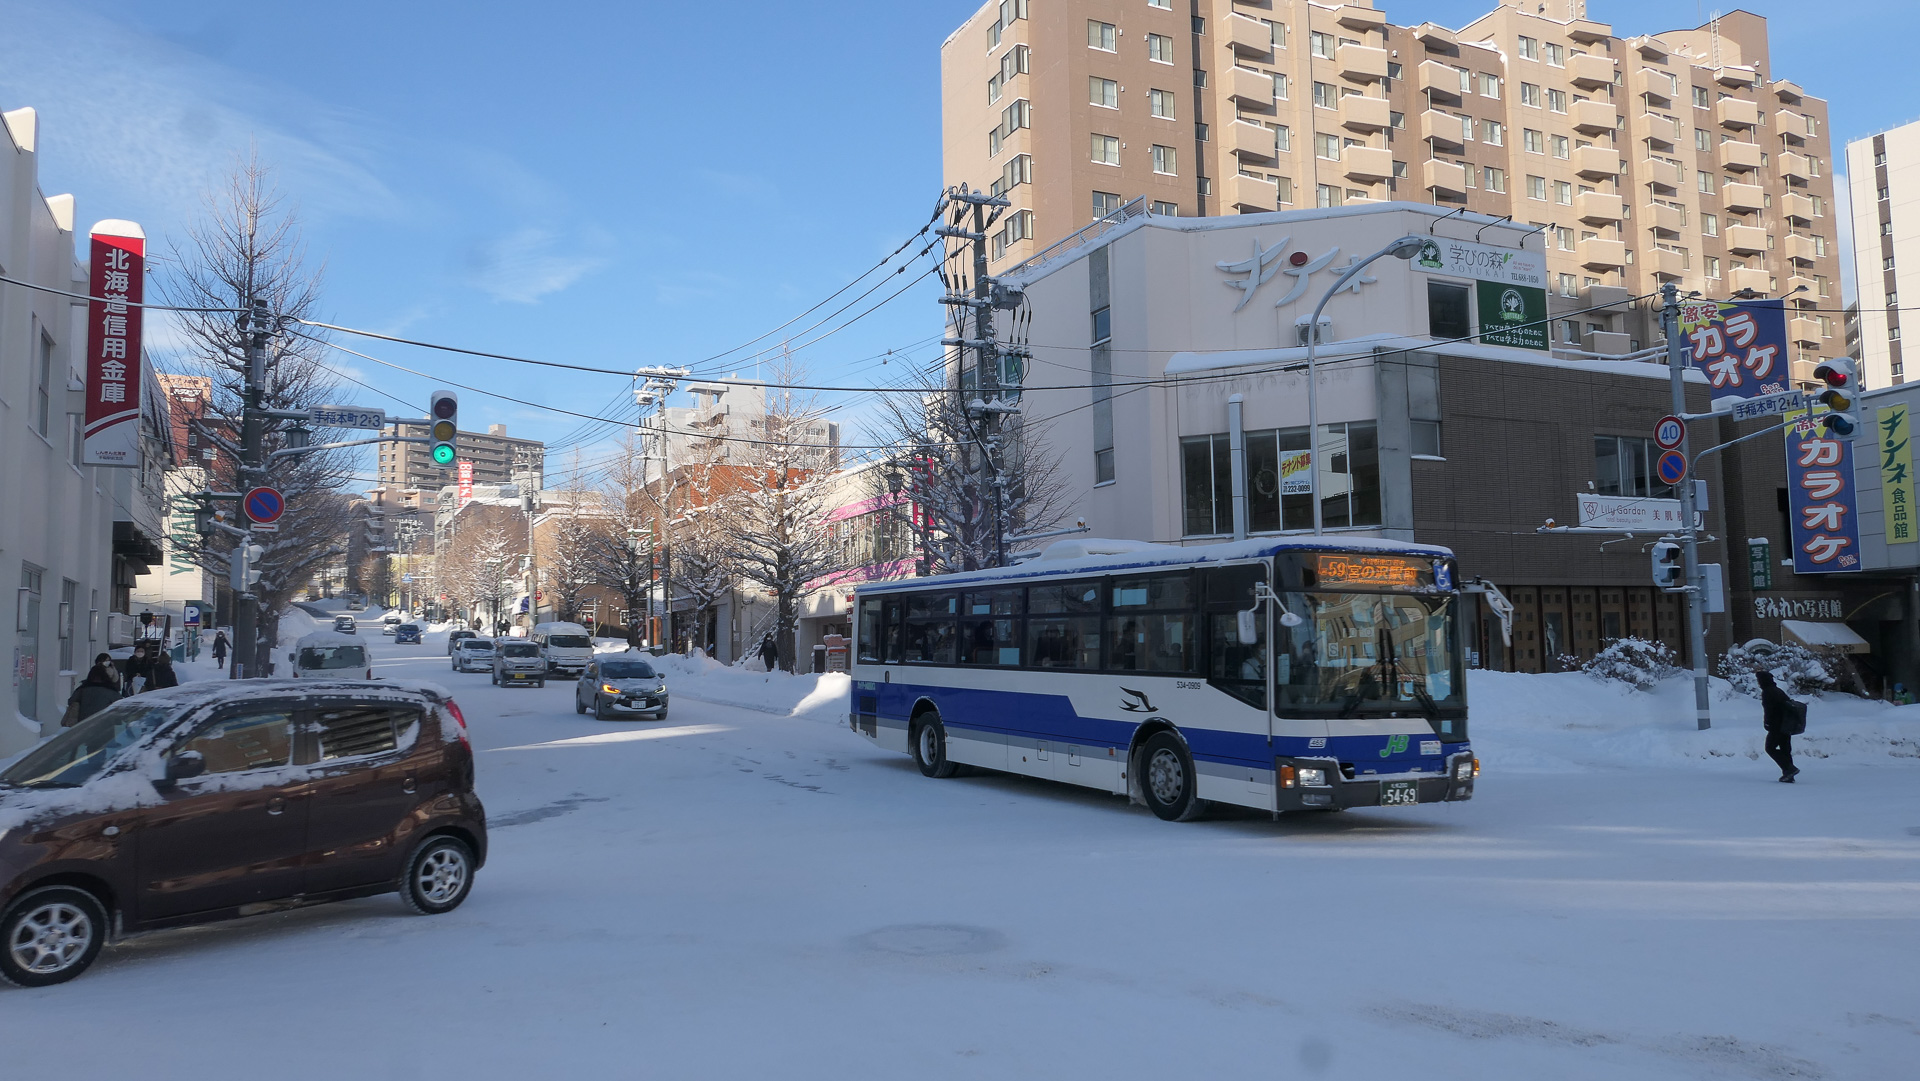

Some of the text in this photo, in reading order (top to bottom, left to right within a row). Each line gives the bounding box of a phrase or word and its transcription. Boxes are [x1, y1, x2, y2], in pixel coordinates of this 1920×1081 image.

[1449, 243, 1504, 271] 学びの森
[1450, 264, 1506, 279] SOYUKAI
[1682, 304, 1718, 323] 激安
[100, 248, 130, 404] 北海道信用金庫
[1661, 425, 1679, 440] 40
[1282, 453, 1311, 475] テナント募集
[1288, 484, 1311, 493] 232-0099
[1799, 438, 1849, 563] カラオケ
[1601, 504, 1646, 516] Lily Garden
[1348, 564, 1418, 581] 宮の沢駅前
[1752, 546, 1765, 588] 写真館
[185, 606, 199, 621] P
[1754, 597, 1842, 618] ぎんれい写真館
[1177, 681, 1201, 689] 534-0909
[1387, 788, 1416, 803] 54-69
